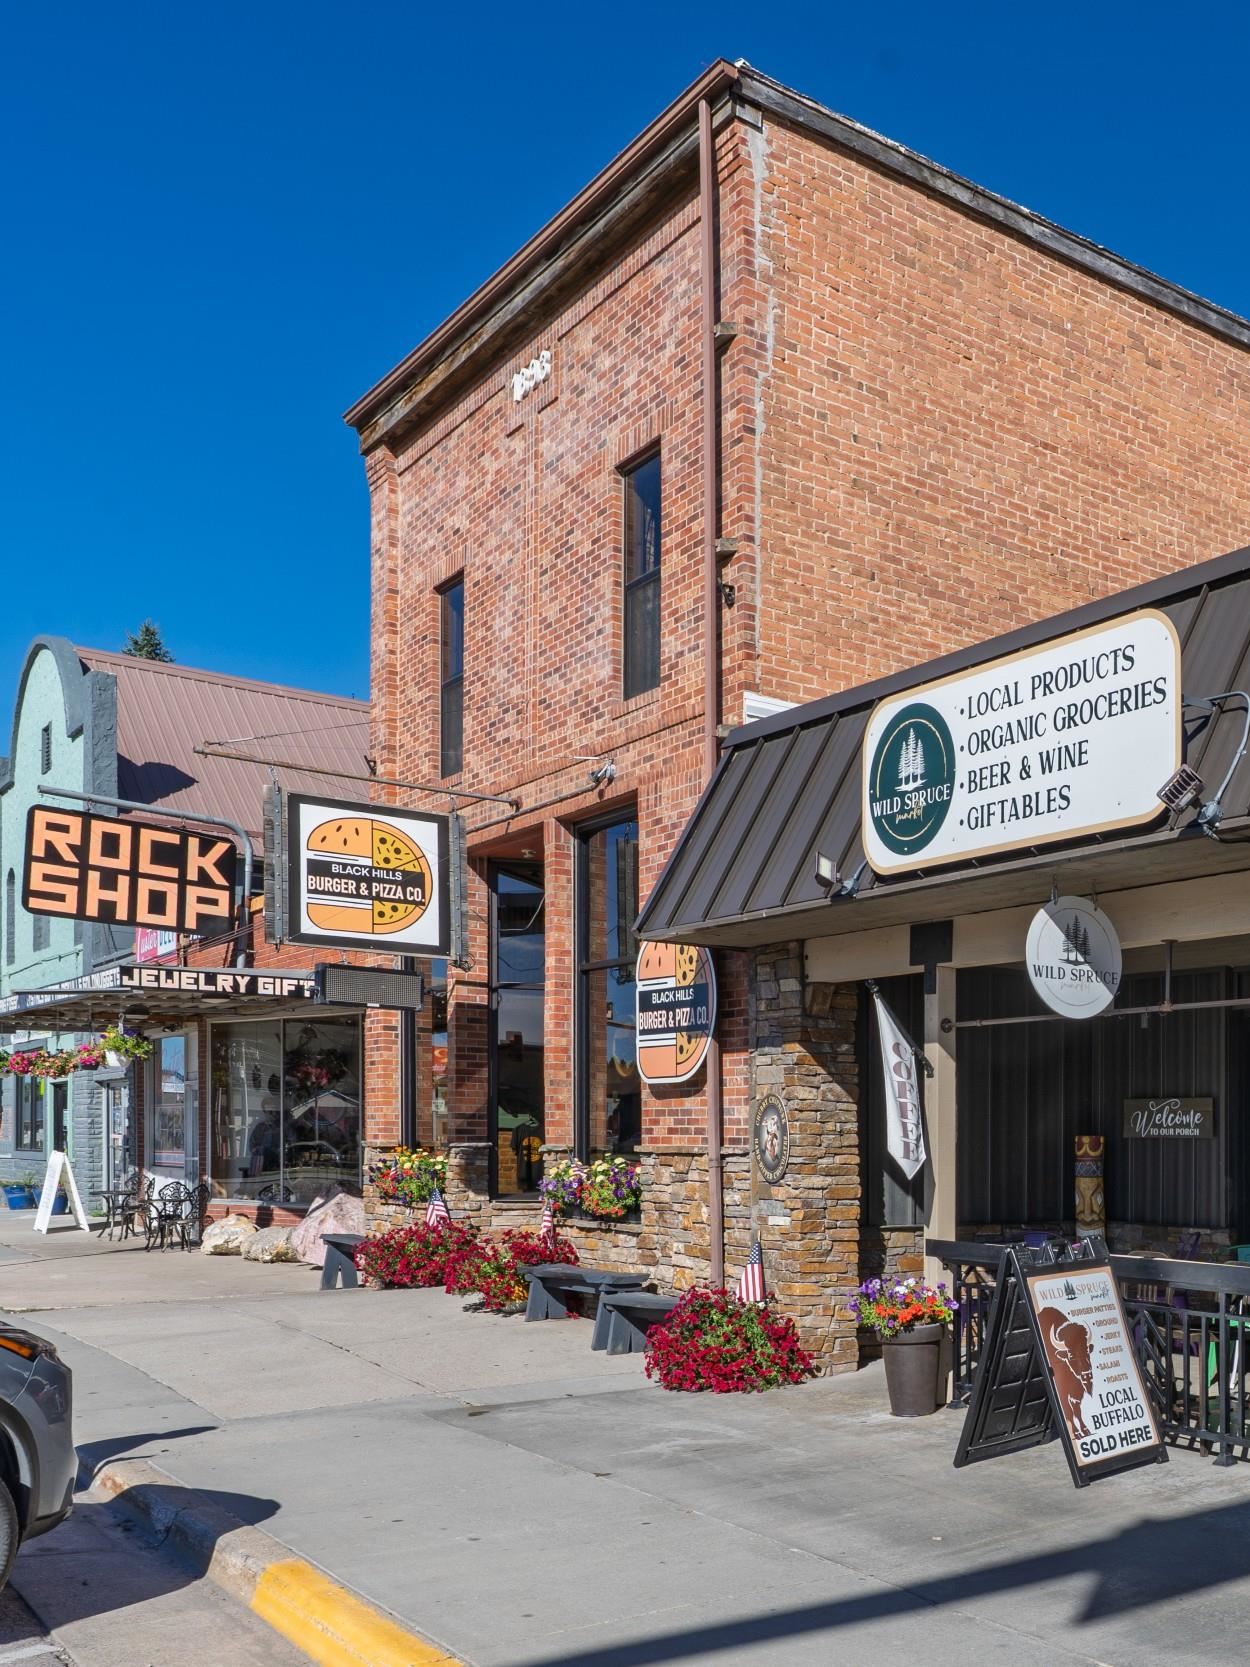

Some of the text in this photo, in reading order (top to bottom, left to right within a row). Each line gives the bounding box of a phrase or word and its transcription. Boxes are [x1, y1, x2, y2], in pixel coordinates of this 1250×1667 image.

[511, 350, 552, 401] 1898
[967, 644, 1135, 720] LOCAL PRODUCTS
[967, 676, 1167, 756] ORGANIC GROCERIES
[967, 739, 1089, 794] BEER & WINE
[873, 783, 951, 818] WILD SPRUCE
[967, 784, 1071, 831] GIFTABLES
[32, 809, 232, 886] ROCK
[331, 863, 402, 881] BLACK HILLS
[28, 861, 230, 930] SHOP
[307, 875, 425, 902] BURGER & PIZZA CO.
[122, 968, 251, 993] JEWELRY
[1032, 964, 1119, 985] WILD SPRUCE
[651, 988, 695, 1004] BLACK HILLS
[639, 1005, 709, 1030] BURGER & PIZZA CO.
[1130, 1098, 1204, 1138] Welcome
[1150, 1127, 1200, 1136] TO OUR PORCH
[1039, 1280, 1110, 1301] WILD SPRUCE
[1104, 1331, 1121, 1340] JERKY
[1102, 1345, 1124, 1355] STEAKS
[1106, 1372, 1129, 1384] ROASTS
[1098, 1386, 1138, 1408] LOCAL
[1091, 1403, 1145, 1430] BUFFALO
[1080, 1425, 1153, 1458] SOLD HERE
